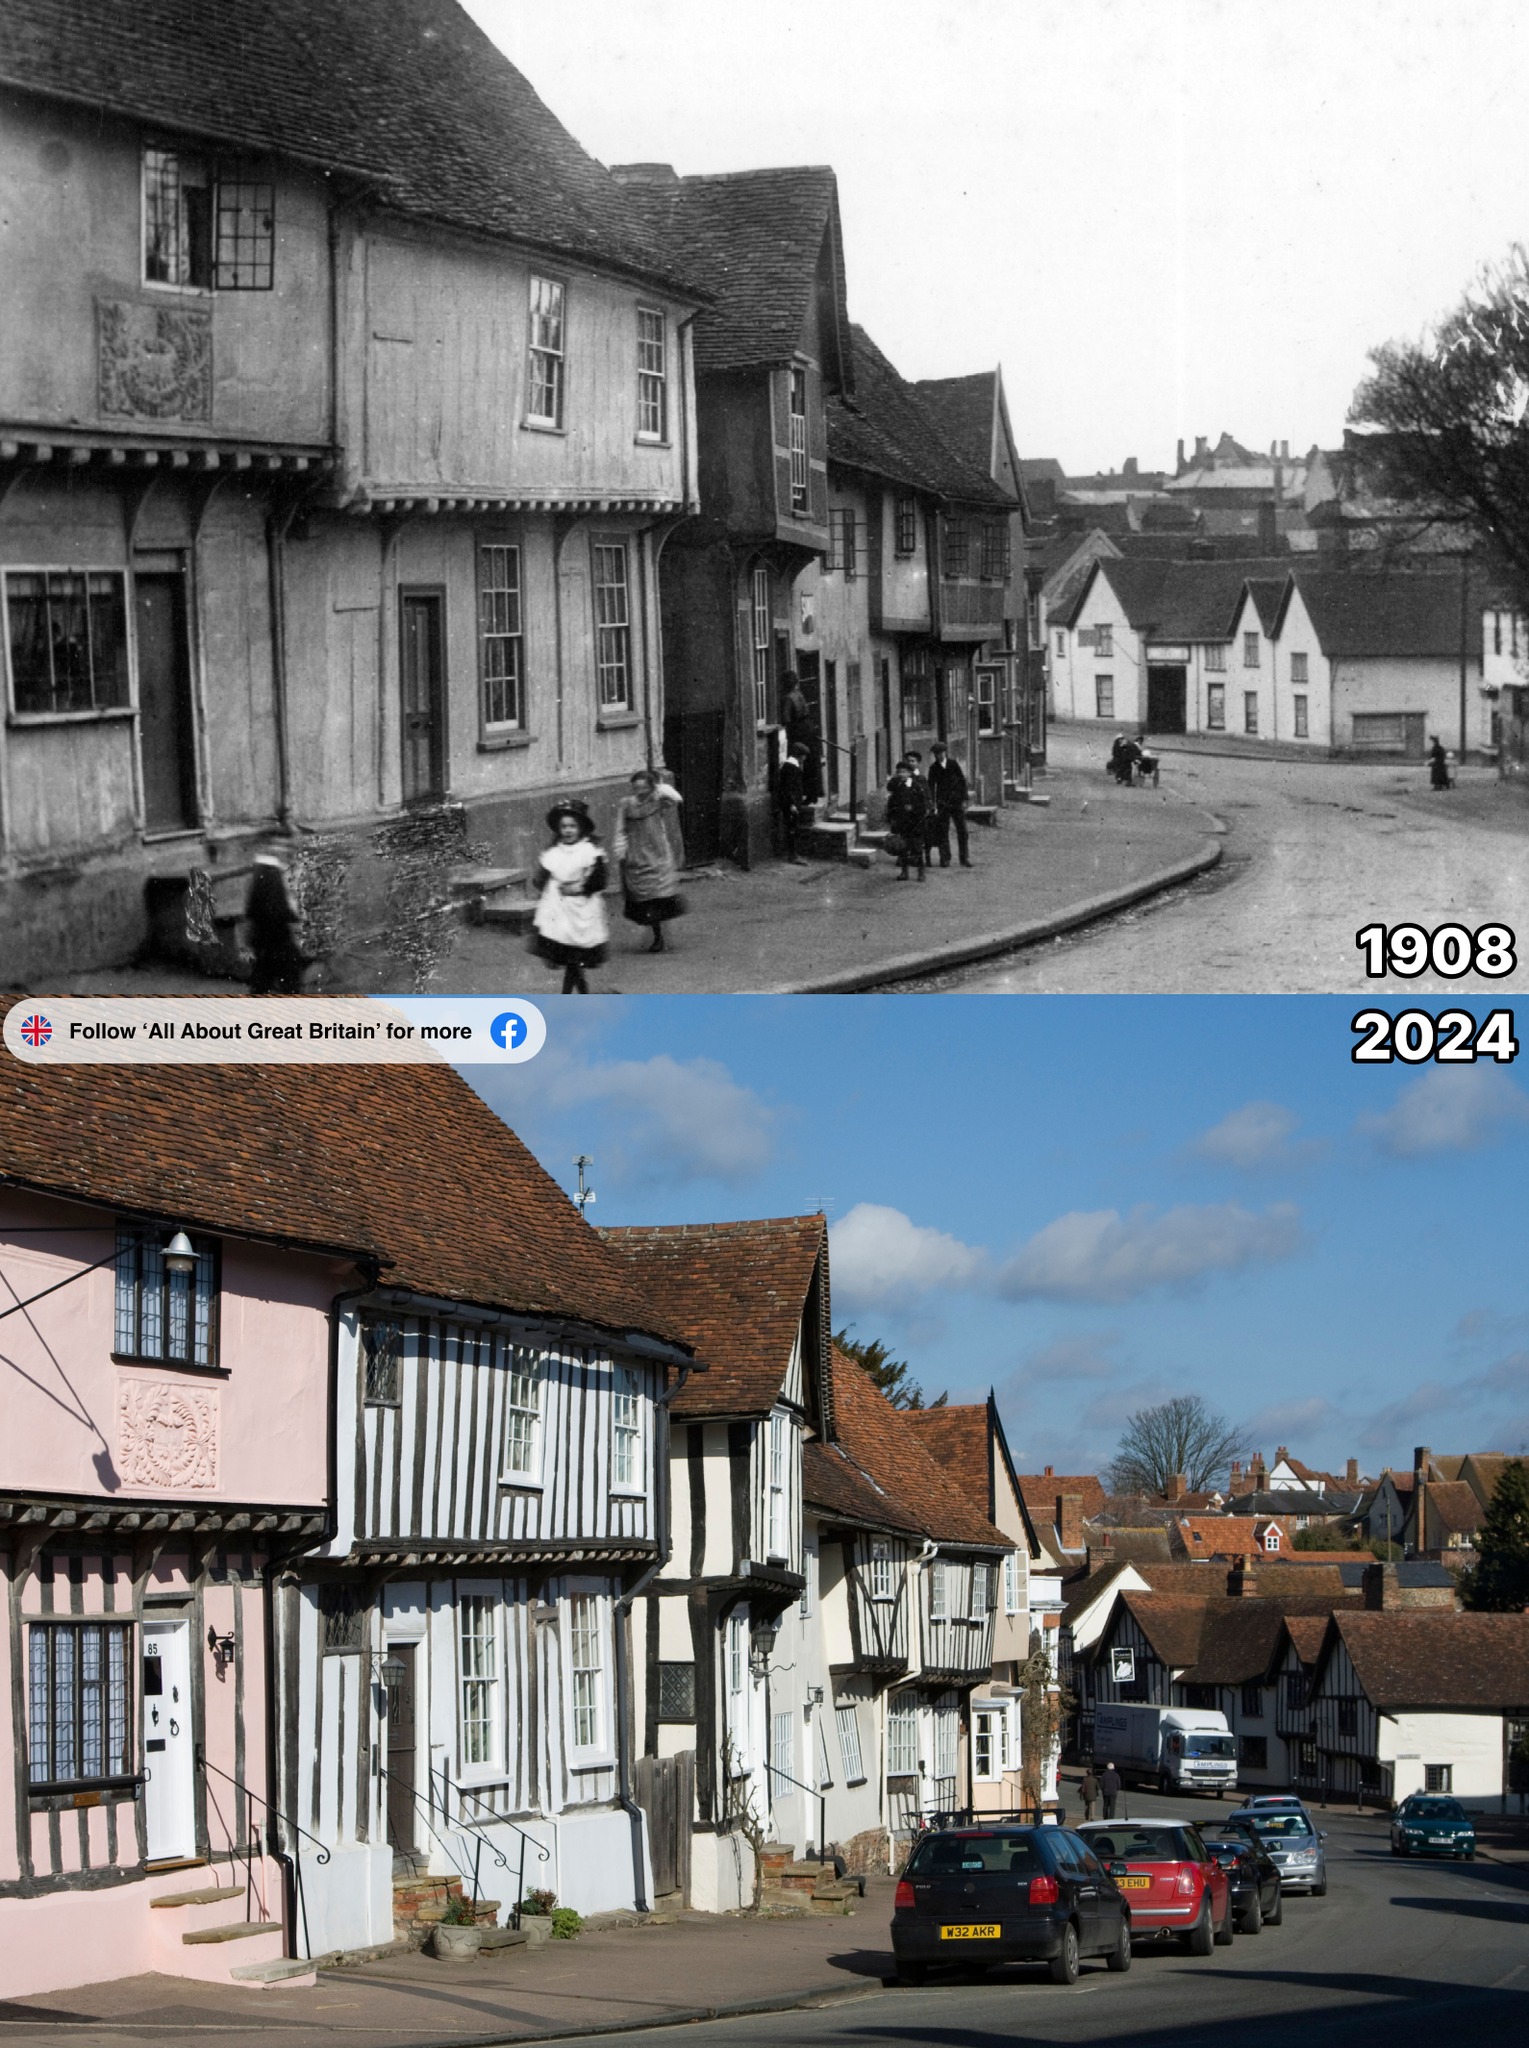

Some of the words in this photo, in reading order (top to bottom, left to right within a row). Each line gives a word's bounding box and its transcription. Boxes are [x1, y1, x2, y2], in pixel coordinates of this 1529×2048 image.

[147, 1643, 158, 1655] 85
[1127, 1878, 1146, 1888] EHU
[946, 1927, 970, 1938] W32
[972, 1926, 996, 1937] AKR
